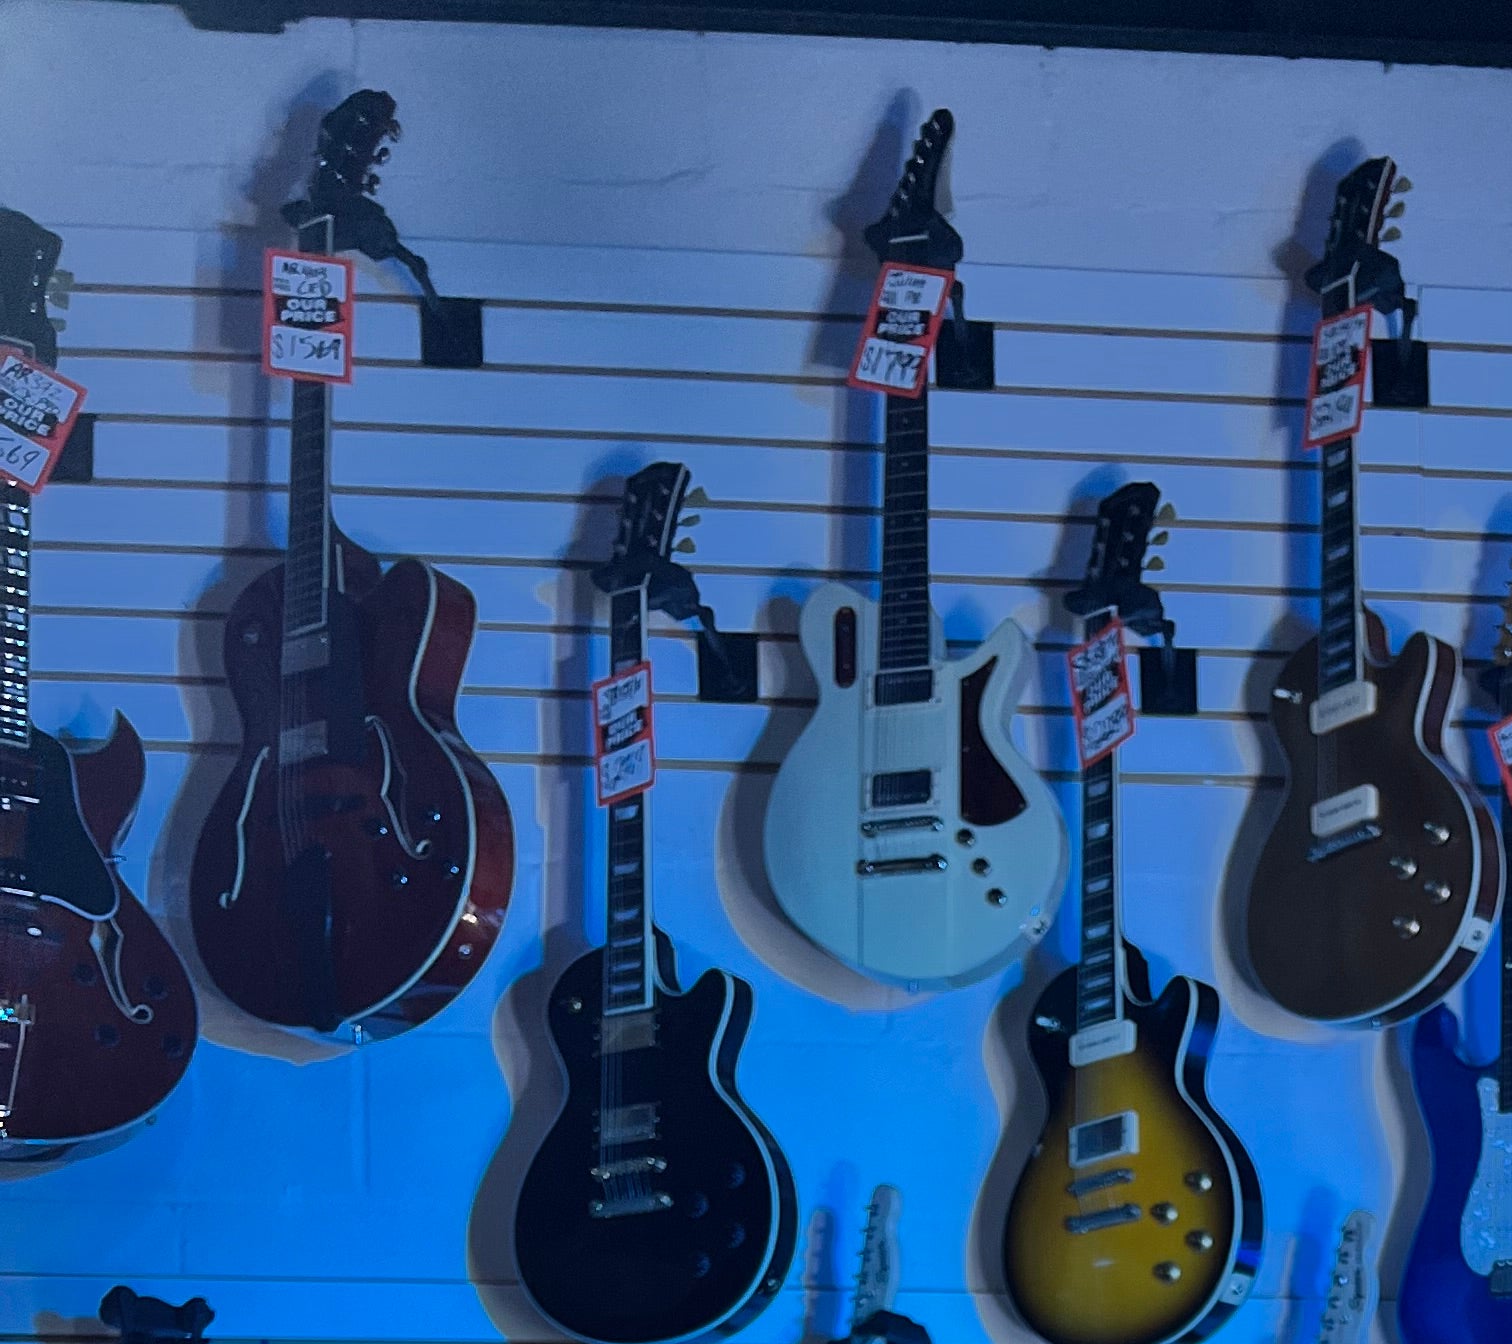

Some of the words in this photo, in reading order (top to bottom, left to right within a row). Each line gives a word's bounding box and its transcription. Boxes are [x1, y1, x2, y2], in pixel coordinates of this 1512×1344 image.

[288, 298, 329, 311] OUR
[282, 310, 339, 324] PRICE
[5, 397, 46, 422] OUR
